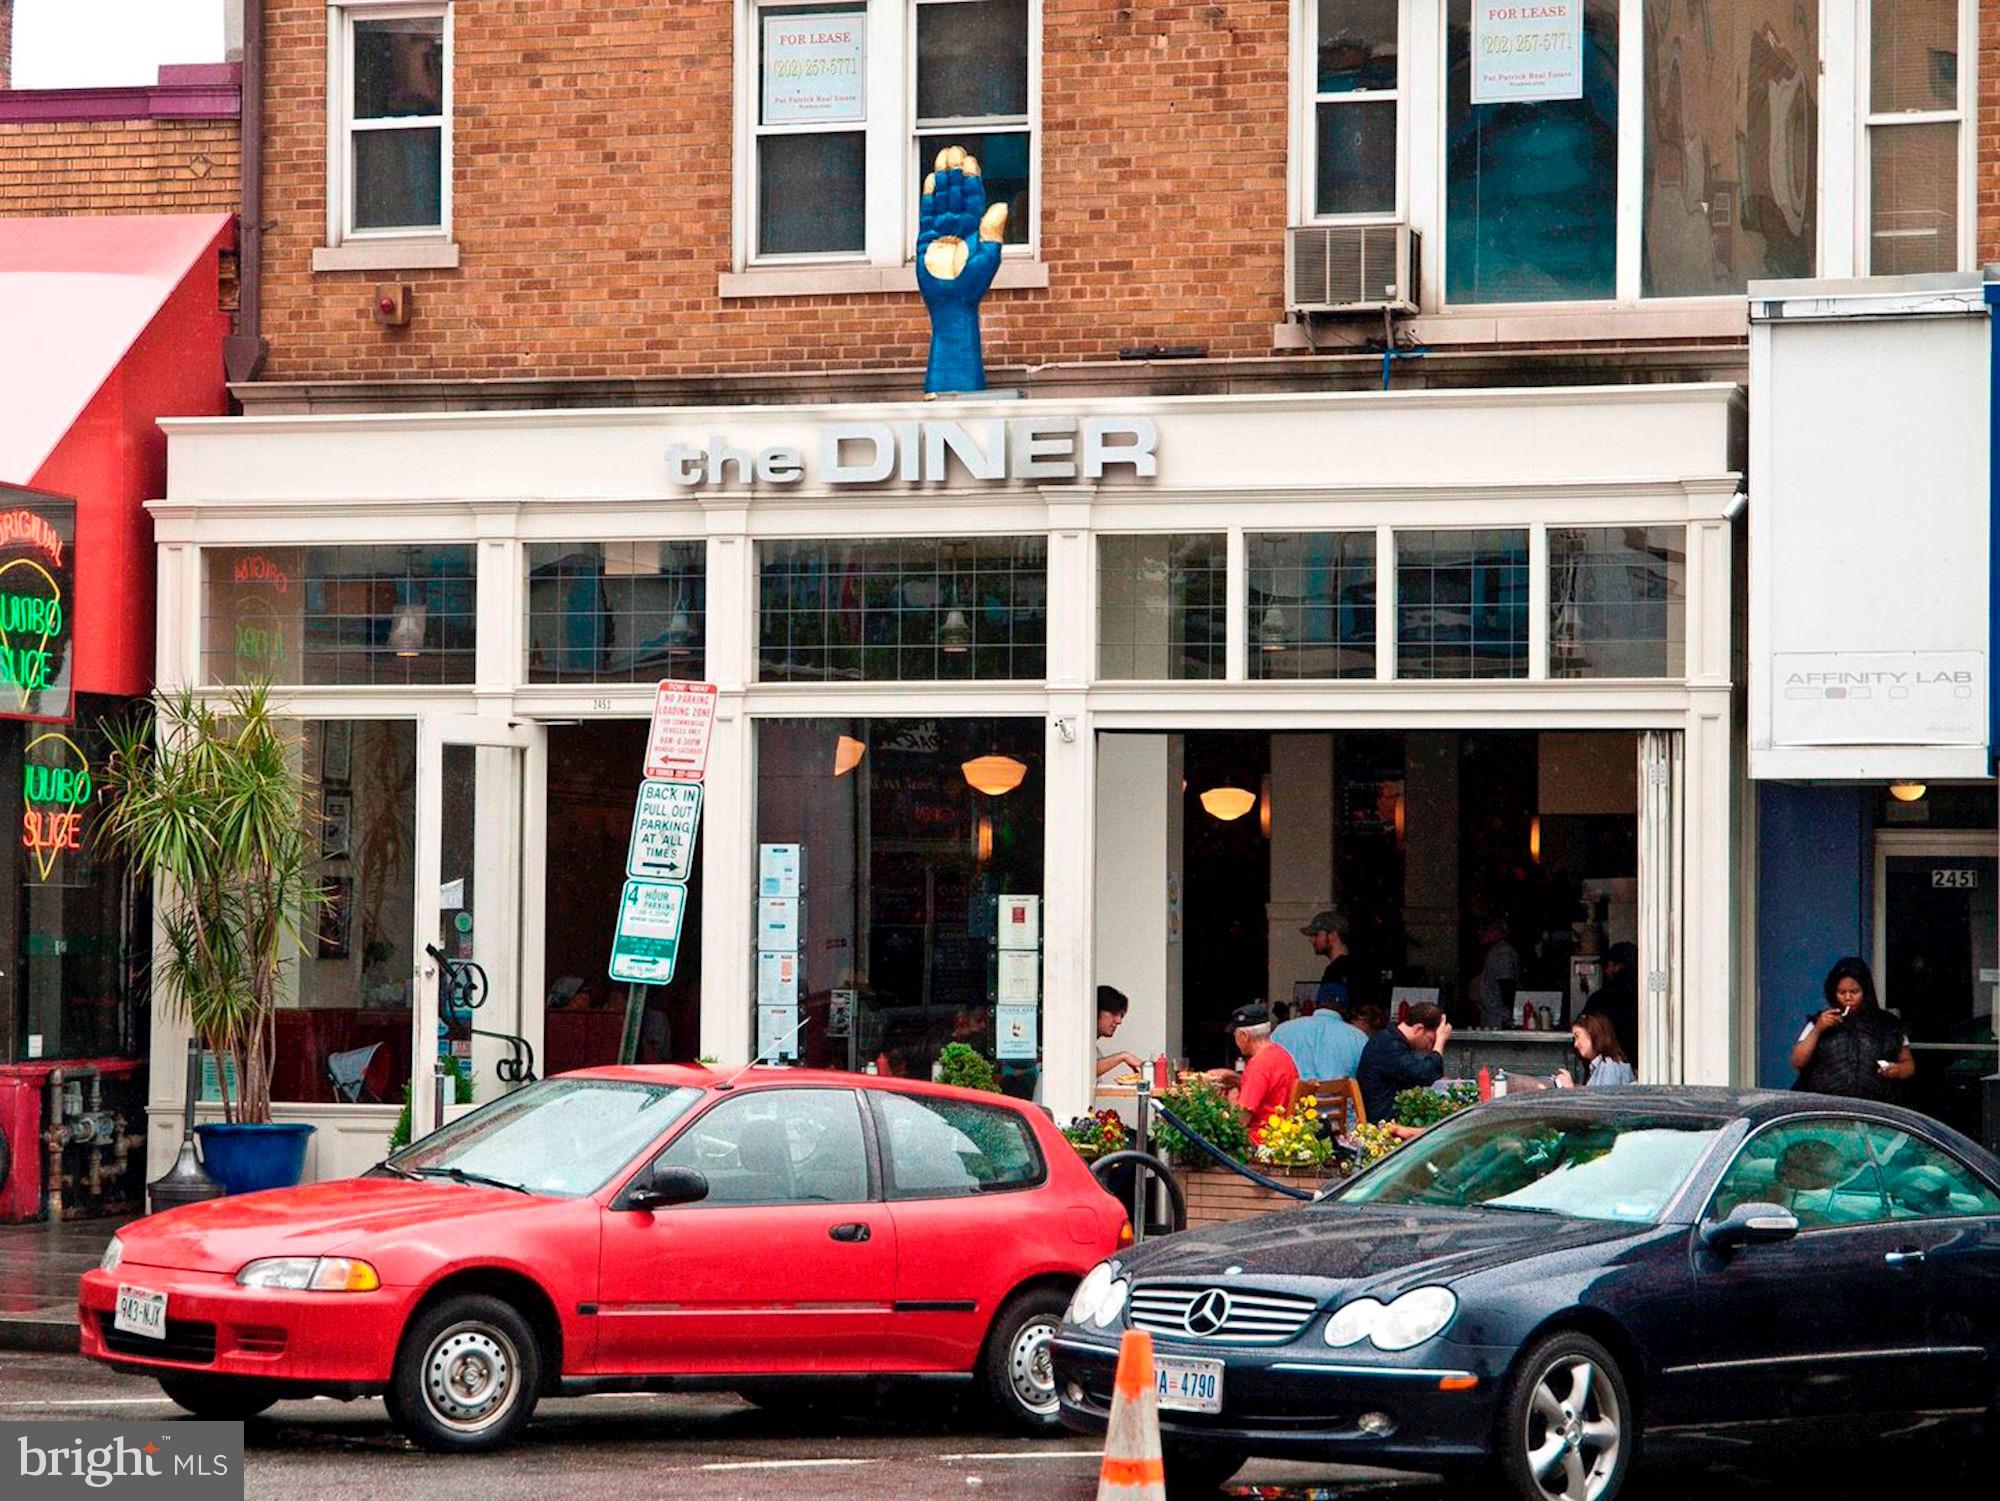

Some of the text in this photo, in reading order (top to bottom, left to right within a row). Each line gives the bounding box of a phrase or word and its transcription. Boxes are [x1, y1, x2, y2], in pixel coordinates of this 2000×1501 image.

[1489, 5, 1567, 21] FOR LEASE
[780, 31, 852, 45] FOR LEASE
[1482, 32, 1573, 56] (202) 257-5771
[774, 56, 858, 78] (202) 257-5771
[665, 415, 1160, 487] the DINER
[1785, 671, 1973, 685] AFFINITY LAB
[665, 693, 710, 705] NO PARKING
[658, 705, 711, 718] LOADING ZONE
[24, 764, 91, 805] JUMBO
[645, 786, 697, 802] BACK IN
[643, 803, 693, 818] PULL OUT
[23, 811, 82, 849] SLICE
[640, 818, 691, 834] PARKING
[641, 833, 685, 847] AT ALL
[645, 847, 678, 860] TIMES
[1934, 871, 1976, 886] 2451
[628, 885, 671, 906] 4 HOUR
[643, 902, 676, 912] PARKING
[1181, 1372, 1216, 1399] 4790
